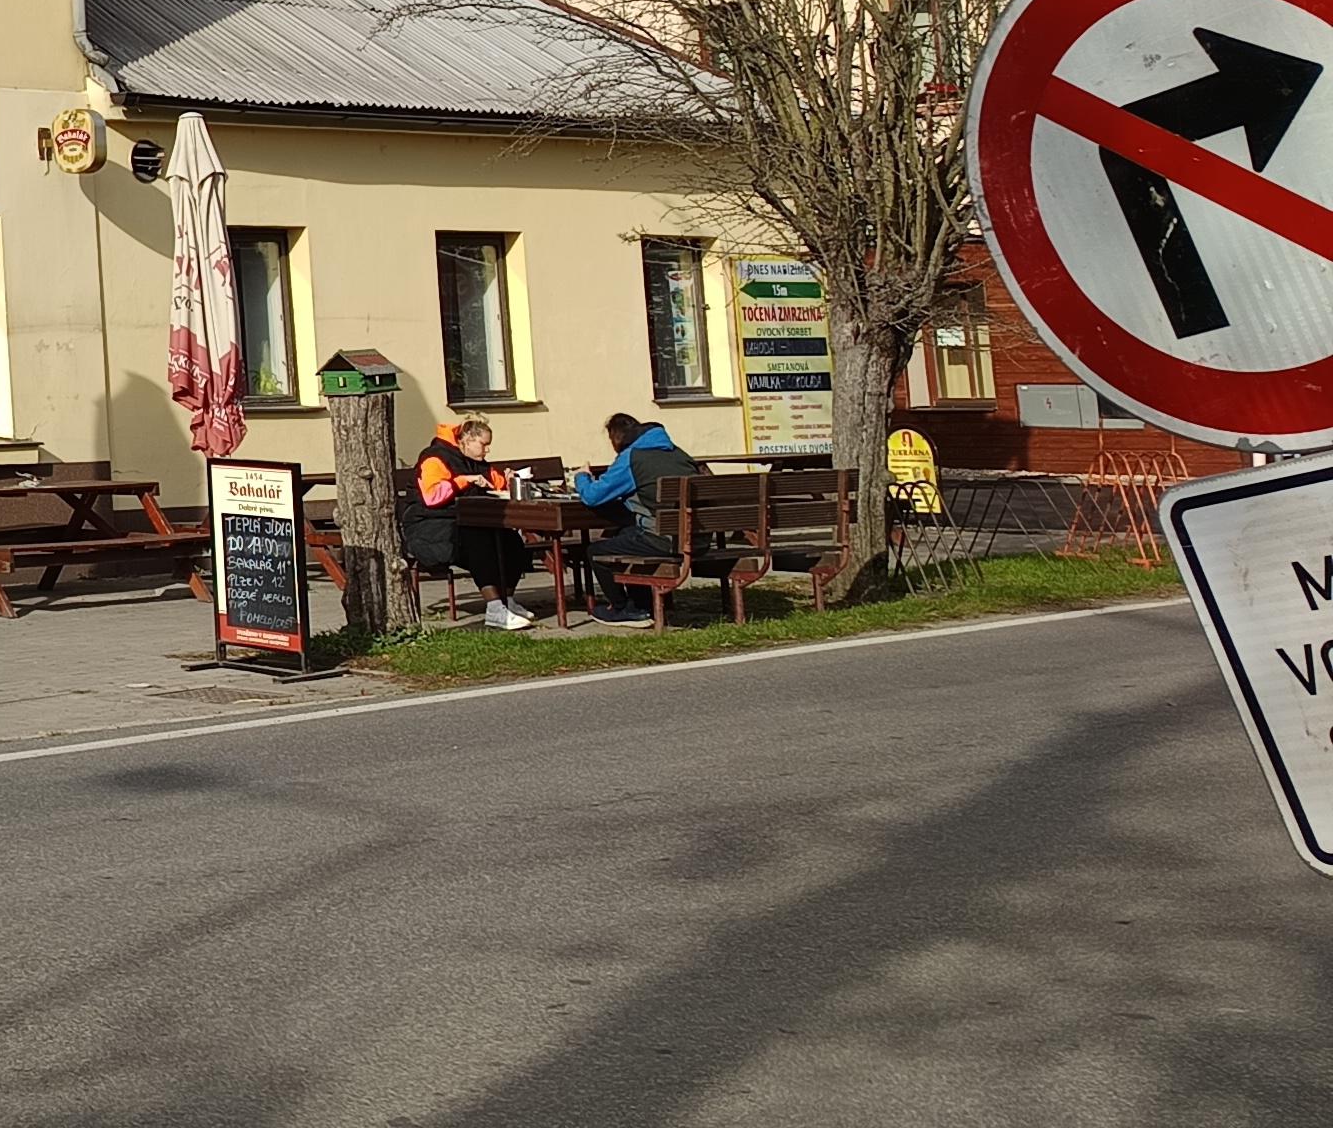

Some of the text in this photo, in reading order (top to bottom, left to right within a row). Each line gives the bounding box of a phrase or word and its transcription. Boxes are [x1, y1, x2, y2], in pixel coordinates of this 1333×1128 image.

[747, 264, 769, 274] DNES
[741, 304, 823, 322] TOČENÁ ZMRZLINA
[757, 326, 812, 336] OVOCNÝ SORBET
[767, 360, 809, 372] SMETANOVÁ
[229, 481, 283, 500] Bakalář
[225, 516, 292, 536] TEPLÁ JÍDLA
[227, 535, 243, 551] DO
[227, 556, 275, 572] BAKALÁŘ
[227, 574, 264, 586] PLZEŇ
